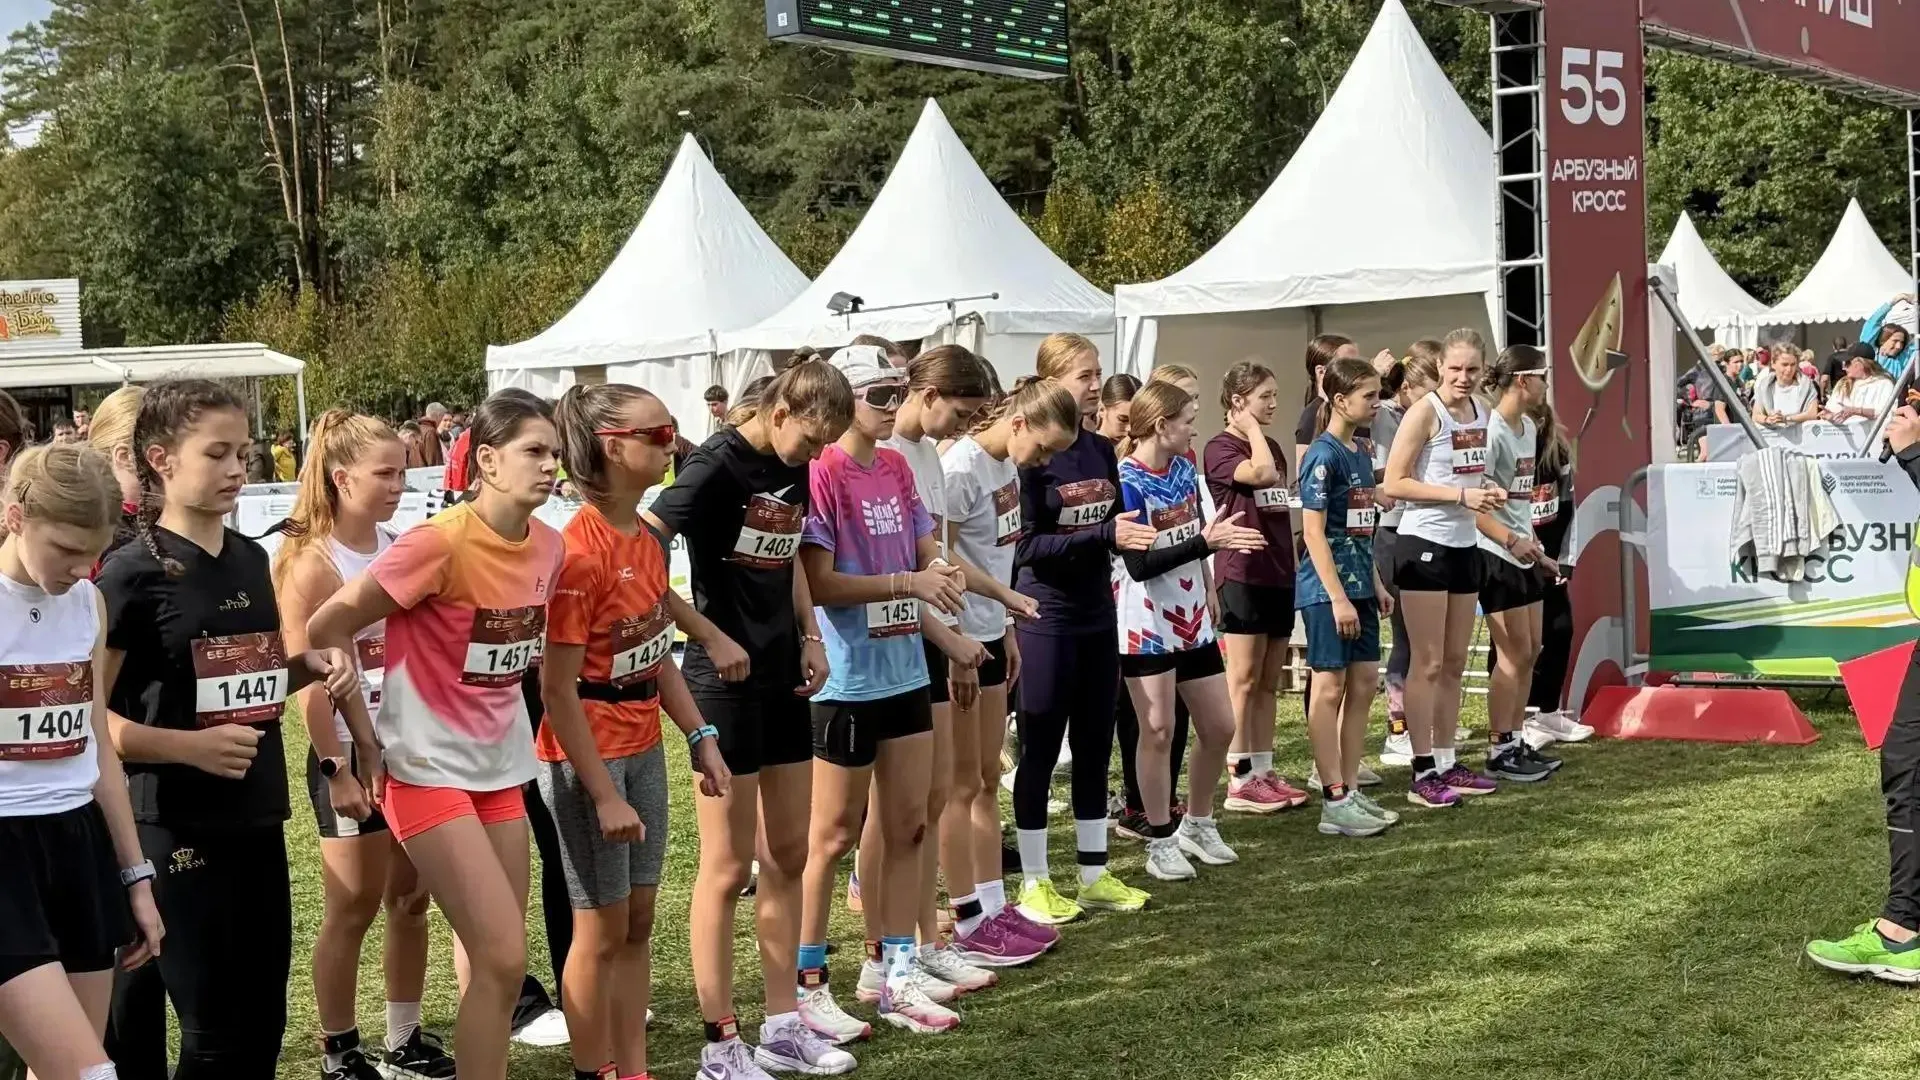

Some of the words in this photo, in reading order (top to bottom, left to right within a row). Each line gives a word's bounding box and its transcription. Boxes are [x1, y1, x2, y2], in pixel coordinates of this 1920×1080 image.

[1560, 47, 1627, 126] 55
[1552, 156, 1638, 182] АРБУЗНЫЙ
[1572, 189, 1627, 213] КРОСС
[0, 289, 58, 309] фейня
[1463, 450, 1487, 464] 144
[1073, 504, 1107, 524] 1448
[1533, 501, 1555, 516] 440
[755, 536, 794, 556] 1403
[1829, 522, 1912, 552] БУЗН
[1730, 554, 1854, 583] КСС
[488, 645, 530, 671] 1451
[628, 633, 669, 670] 1422
[218, 675, 277, 707] 1447
[17, 708, 84, 740] 1404
